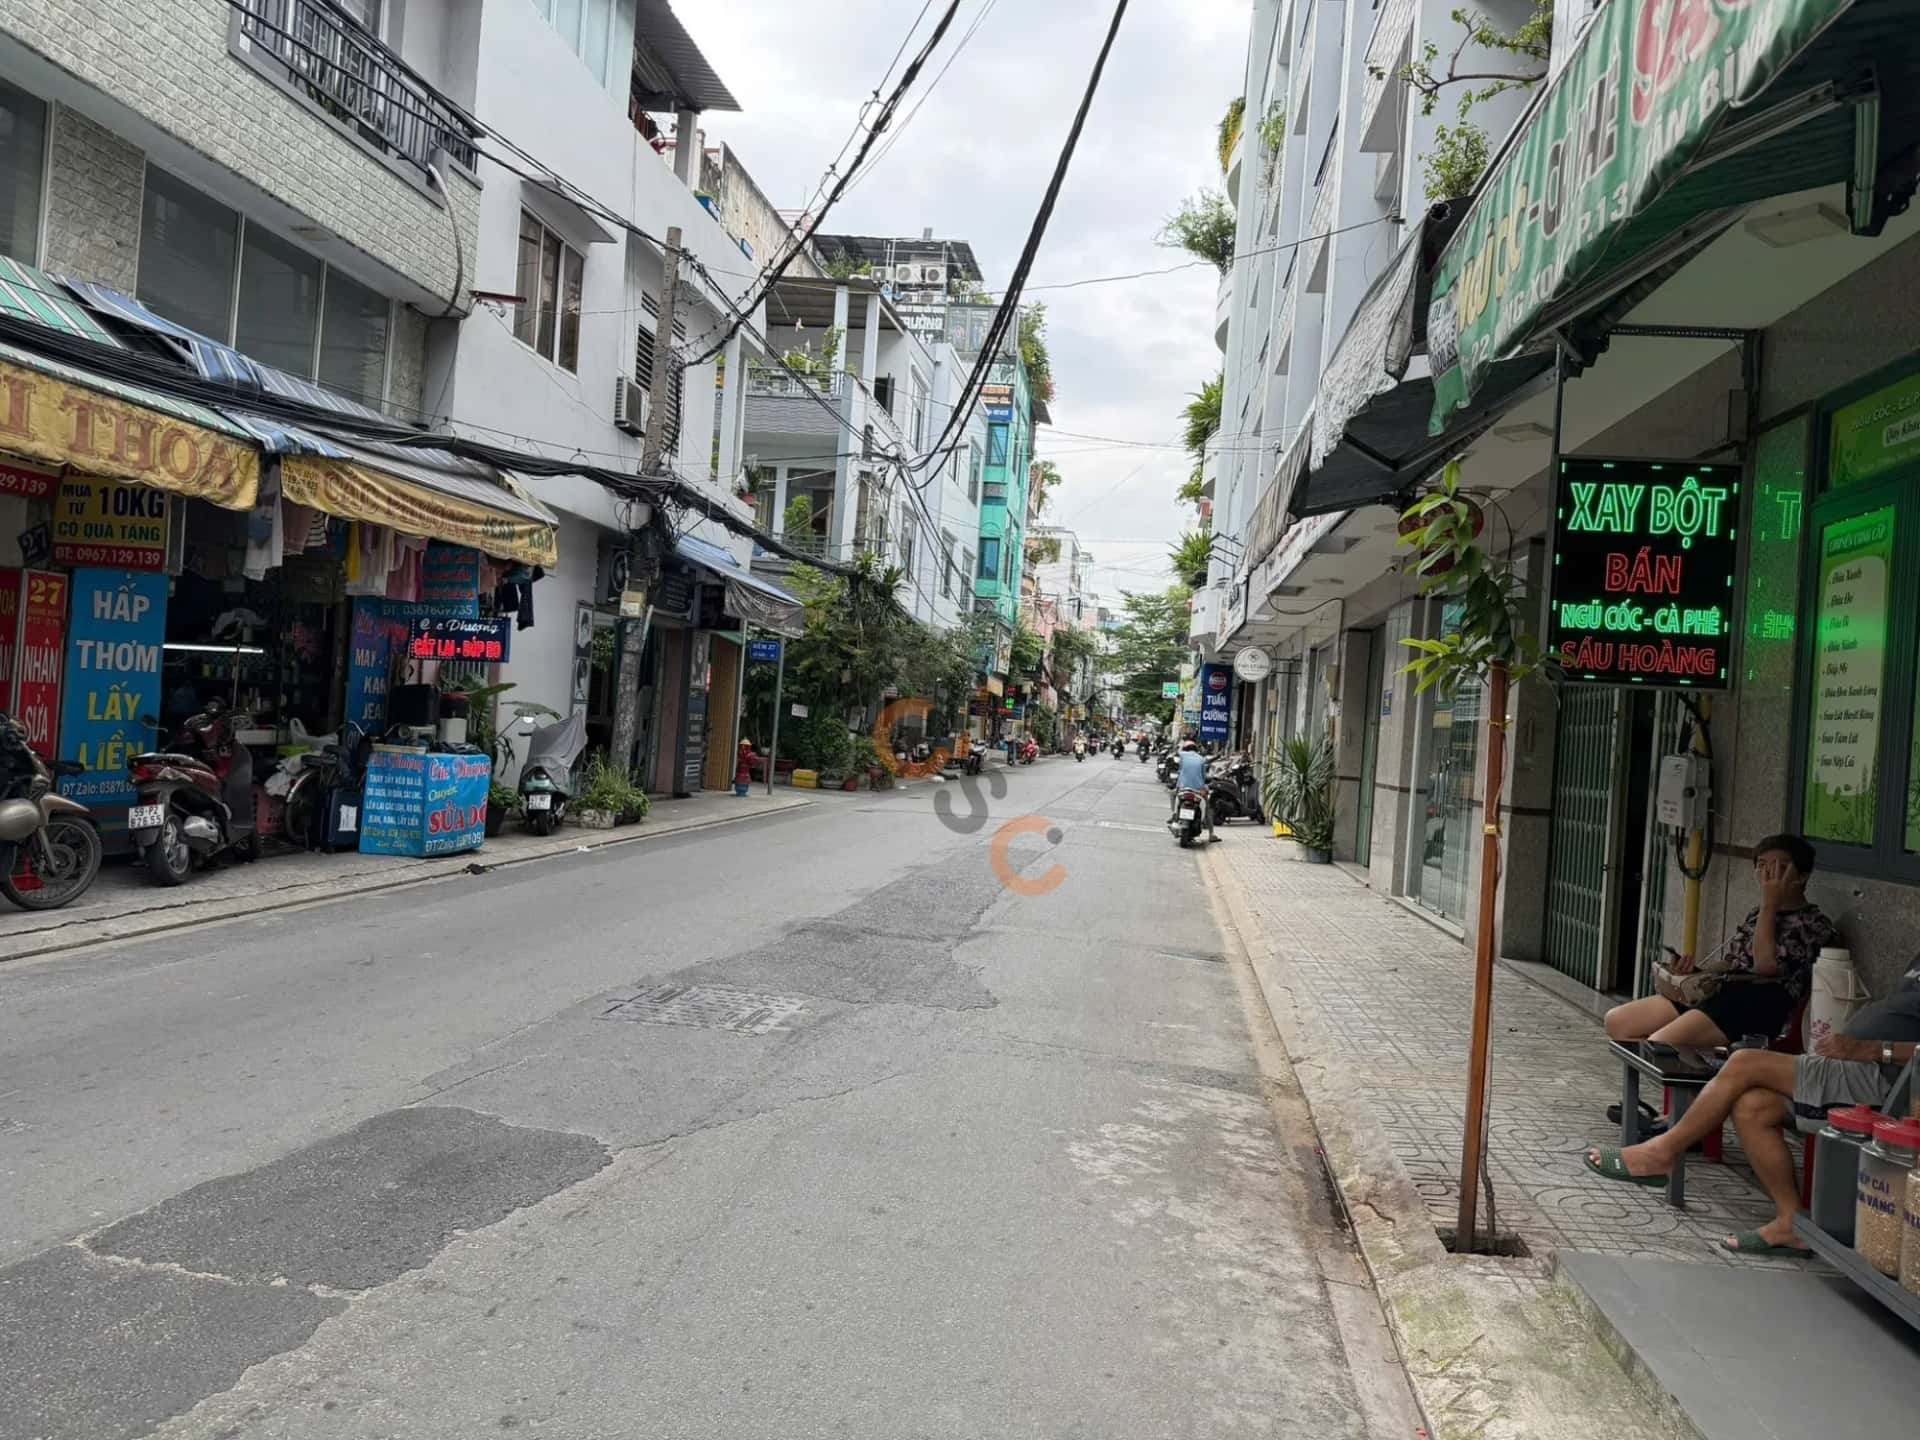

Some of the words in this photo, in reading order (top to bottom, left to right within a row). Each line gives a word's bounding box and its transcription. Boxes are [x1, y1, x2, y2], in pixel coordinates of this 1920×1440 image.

[98, 486, 165, 519] 10KG
[1567, 481, 1645, 533] XAY
[1649, 476, 1727, 549] BỘT
[76, 547, 161, 566] 0967.129.139
[30, 578, 63, 607] 27
[93, 583, 150, 623] HẤP
[1604, 598, 1643, 631] CỐC
[1654, 602, 1680, 633] CÀ
[1682, 605, 1721, 636] PHÊ
[23, 637, 58, 692] NHẬN
[76, 639, 159, 673] THƠM
[1617, 639, 1716, 675] HOÀNG
[87, 681, 142, 721] LẤY
[1202, 709, 1228, 721] CƯỜNG
[1206, 692, 1226, 706] TUẤN
[25, 693, 49, 744] SỬA
[428, 799, 465, 834] SỬA
